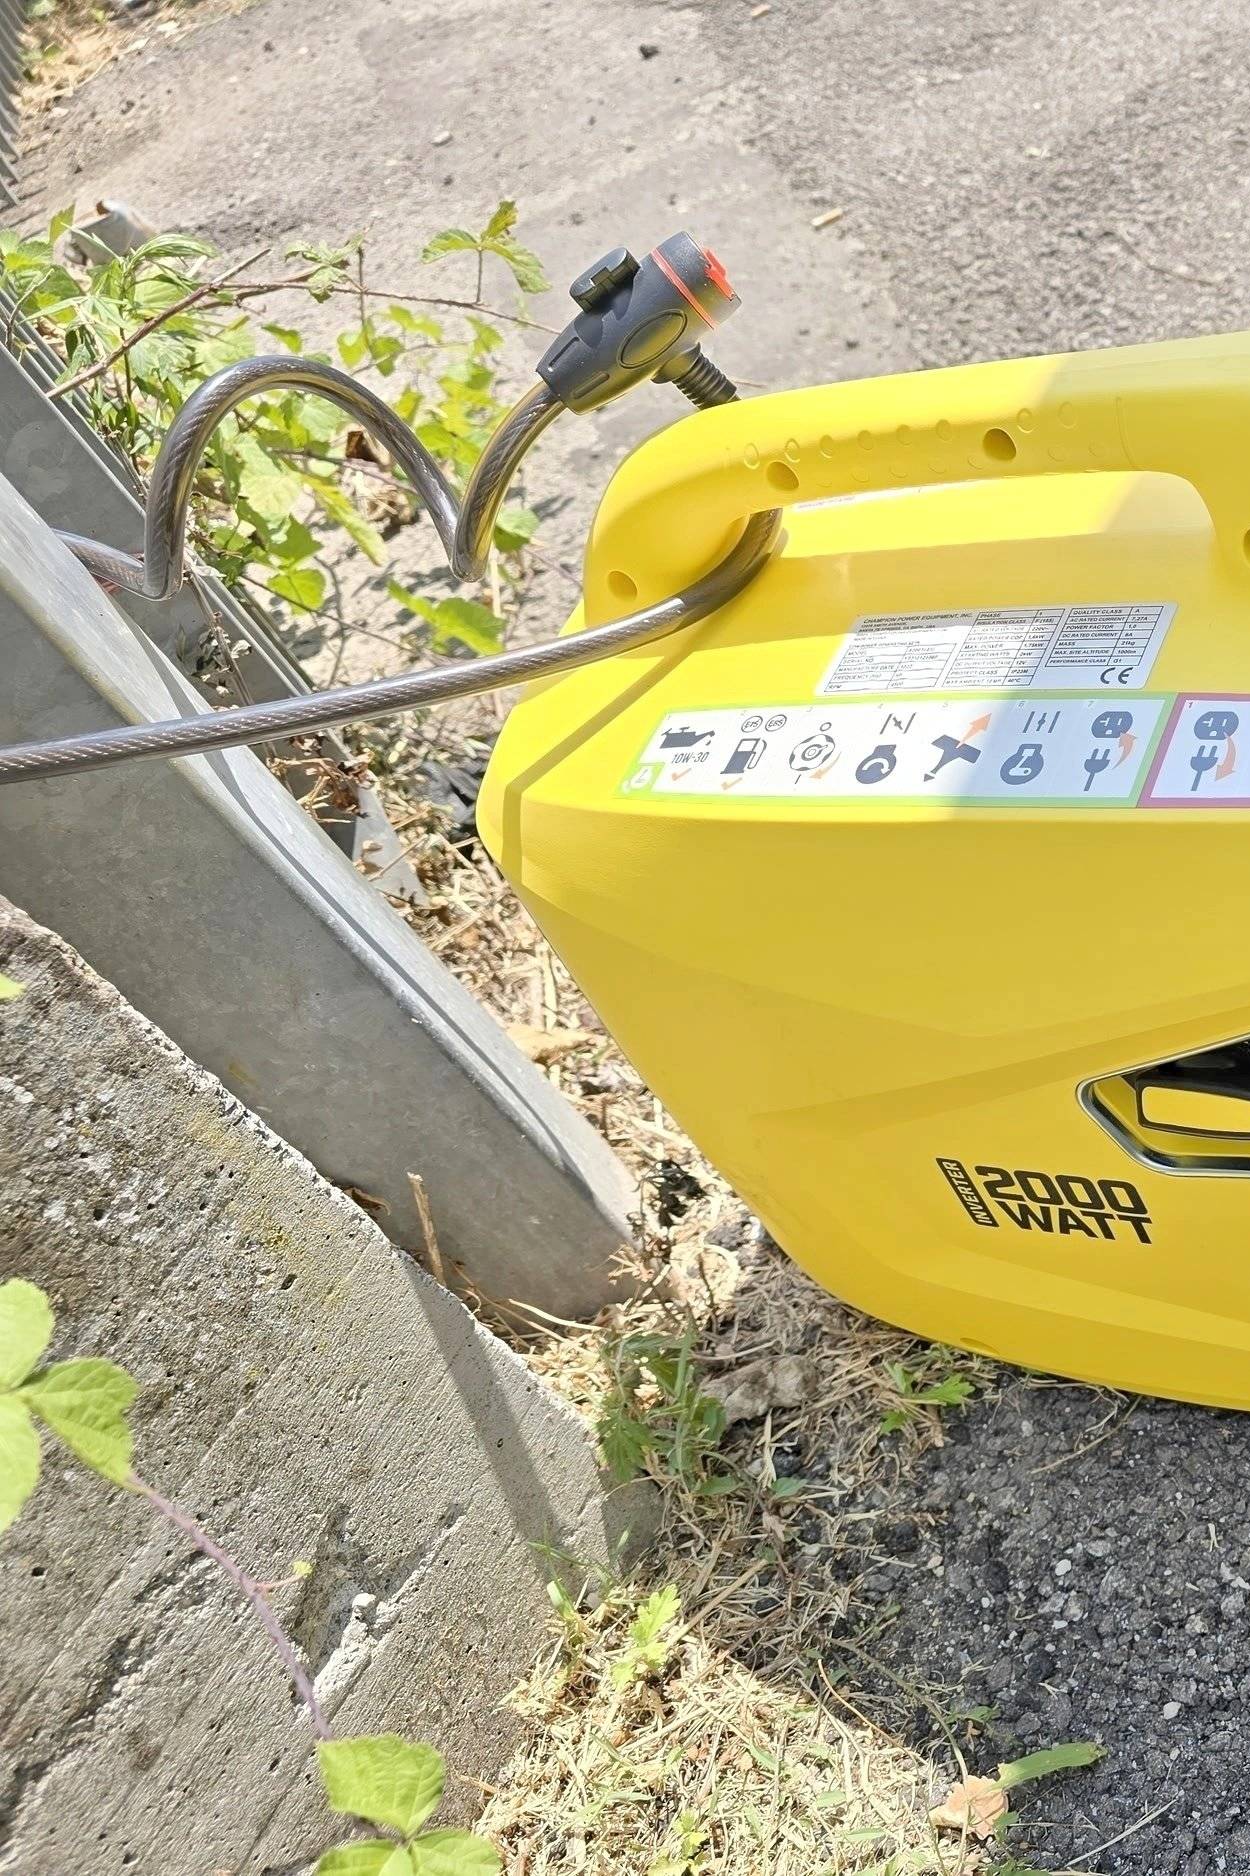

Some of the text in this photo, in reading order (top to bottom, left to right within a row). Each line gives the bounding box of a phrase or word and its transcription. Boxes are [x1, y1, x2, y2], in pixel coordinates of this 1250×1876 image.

[863, 616, 897, 624] CHAMPION
[1100, 667, 1134, 684] CE
[1188, 701, 1194, 710] 1
[672, 752, 710, 764] 10W-30
[942, 1160, 993, 1225] INVERTER
[974, 1165, 1149, 1215] 2000
[993, 1199, 1153, 1245] WATT
